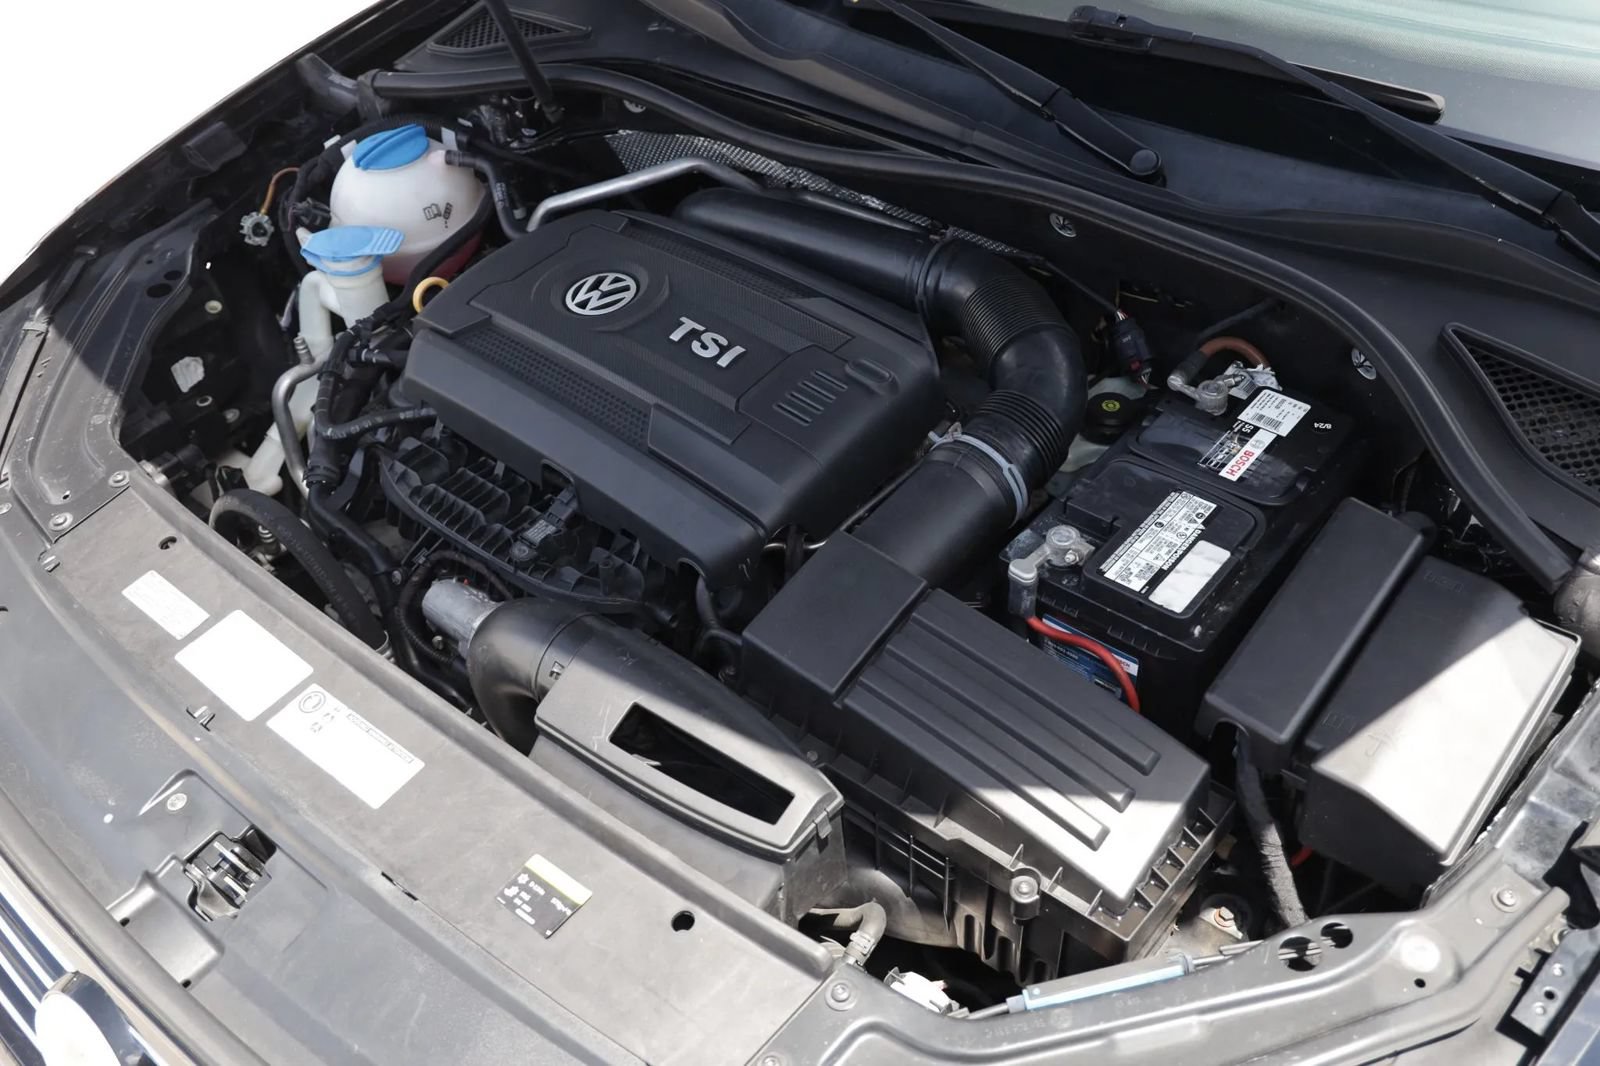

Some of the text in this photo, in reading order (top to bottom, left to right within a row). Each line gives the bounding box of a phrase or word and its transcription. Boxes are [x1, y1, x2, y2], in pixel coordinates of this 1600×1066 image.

[669, 316, 747, 368] TSI
[1241, 423, 1254, 434] S5
[1225, 450, 1256, 477] BOSCH
